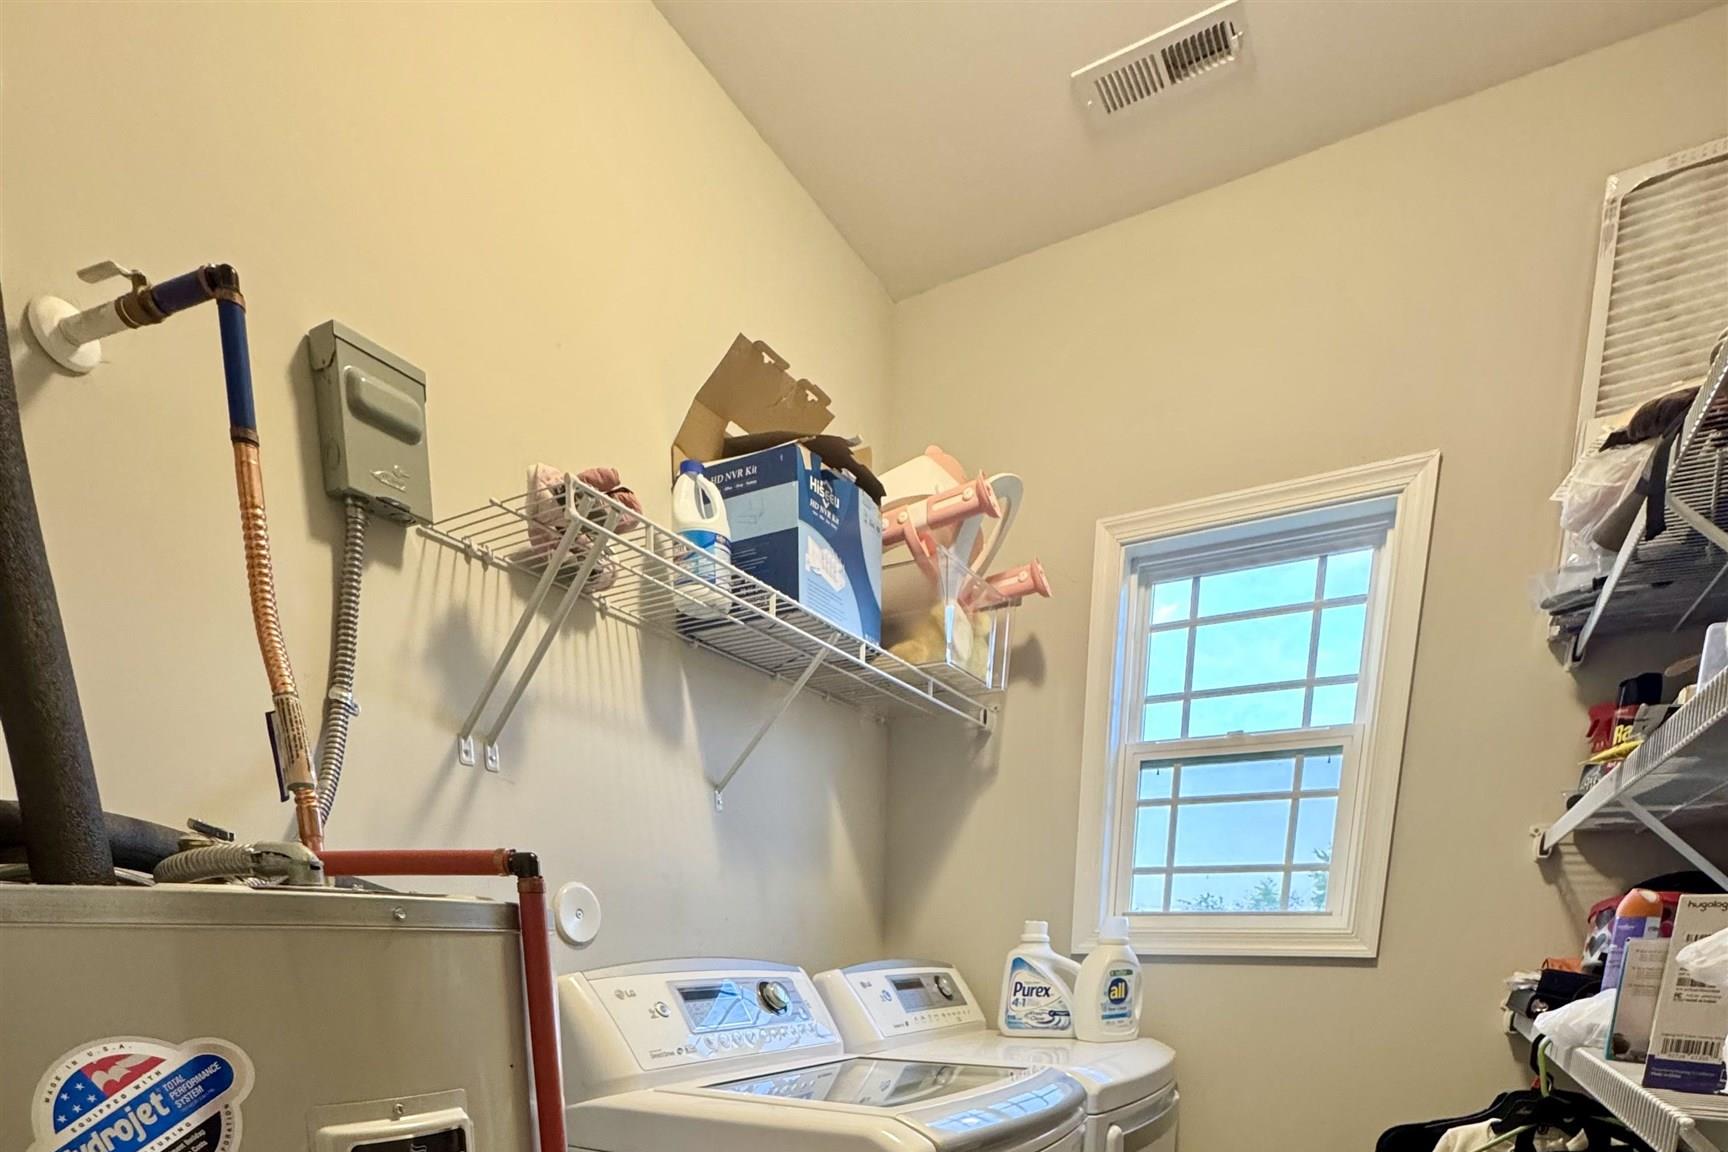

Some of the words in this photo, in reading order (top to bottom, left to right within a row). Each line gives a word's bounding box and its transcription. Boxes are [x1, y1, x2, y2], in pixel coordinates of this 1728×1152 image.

[725, 468, 743, 481] NVR
[745, 464, 757, 476] Kit
[1013, 981, 1051, 997] Purex
[1110, 981, 1125, 999] all
[45, 1076, 61, 1103] MADE
[65, 1060, 78, 1070] IN
[162, 1074, 186, 1092] TOTAL
[169, 1061, 222, 1100] PERFORMANCE
[71, 1093, 128, 1134] EQUIPPED
[133, 1070, 163, 1091] WITH
[174, 1084, 204, 1109] SYSTEM
